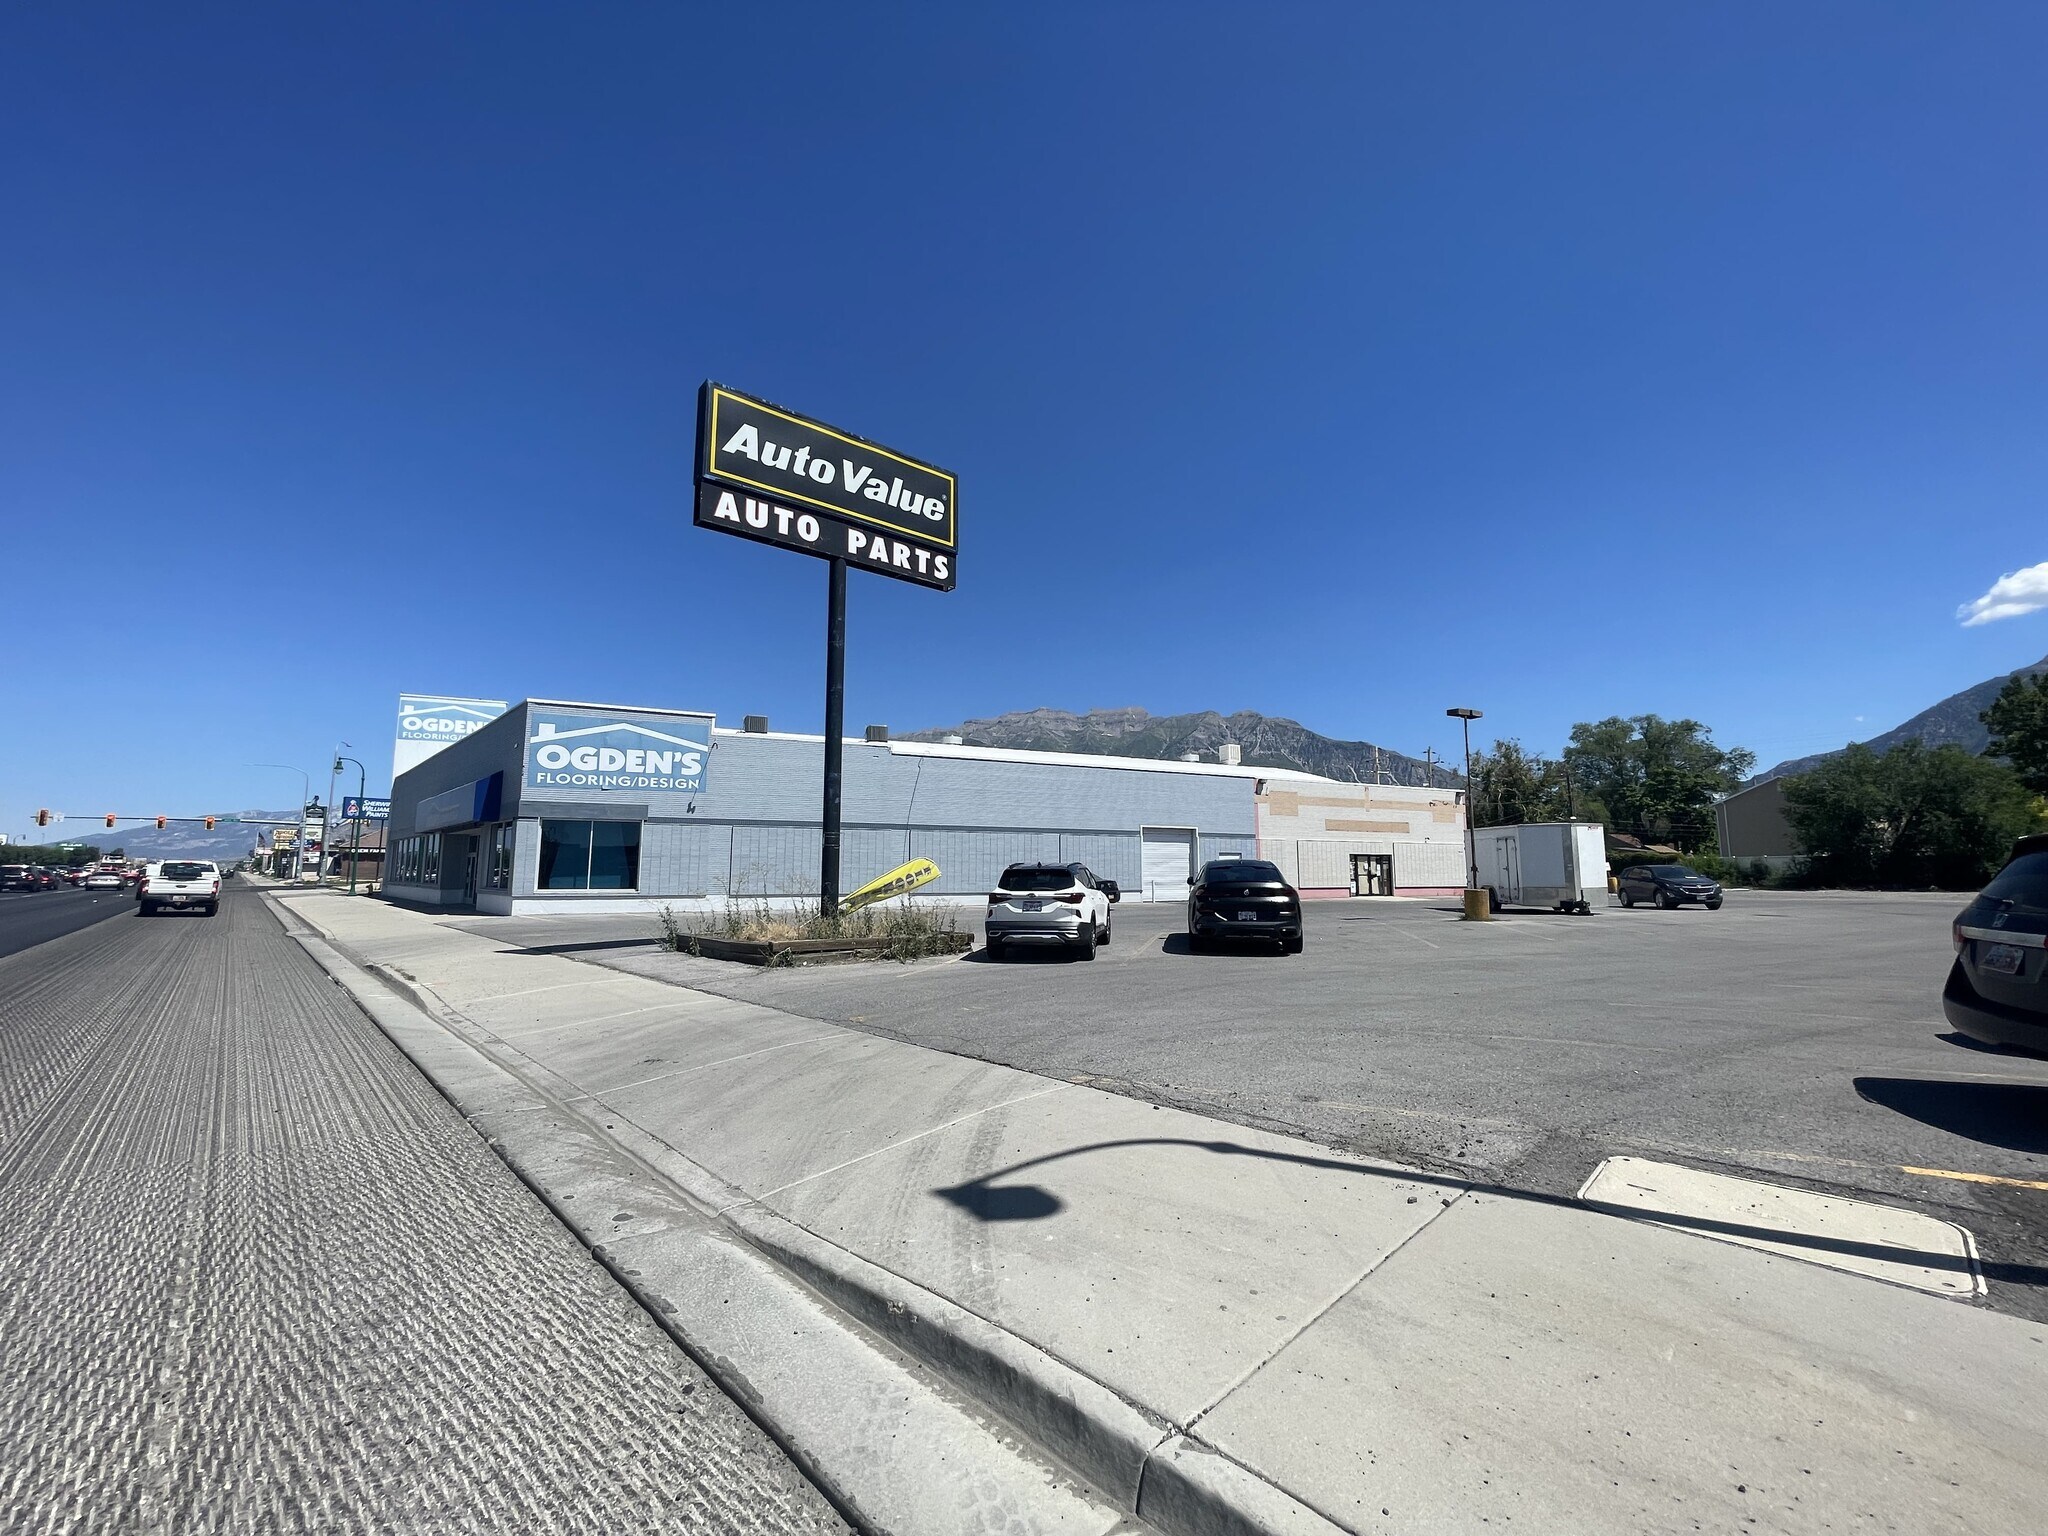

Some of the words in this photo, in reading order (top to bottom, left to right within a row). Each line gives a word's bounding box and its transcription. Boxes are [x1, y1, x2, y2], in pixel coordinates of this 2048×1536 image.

[722, 423, 836, 485] Auto
[842, 458, 945, 522] Value
[714, 491, 820, 543] AUTO
[848, 528, 949, 580] PARTS
[402, 716, 489, 734] OGDEN
[402, 731, 466, 742] FLOORING/
[536, 744, 702, 776] OGDEN'S
[536, 772, 700, 789] FLOORING/DESIGN
